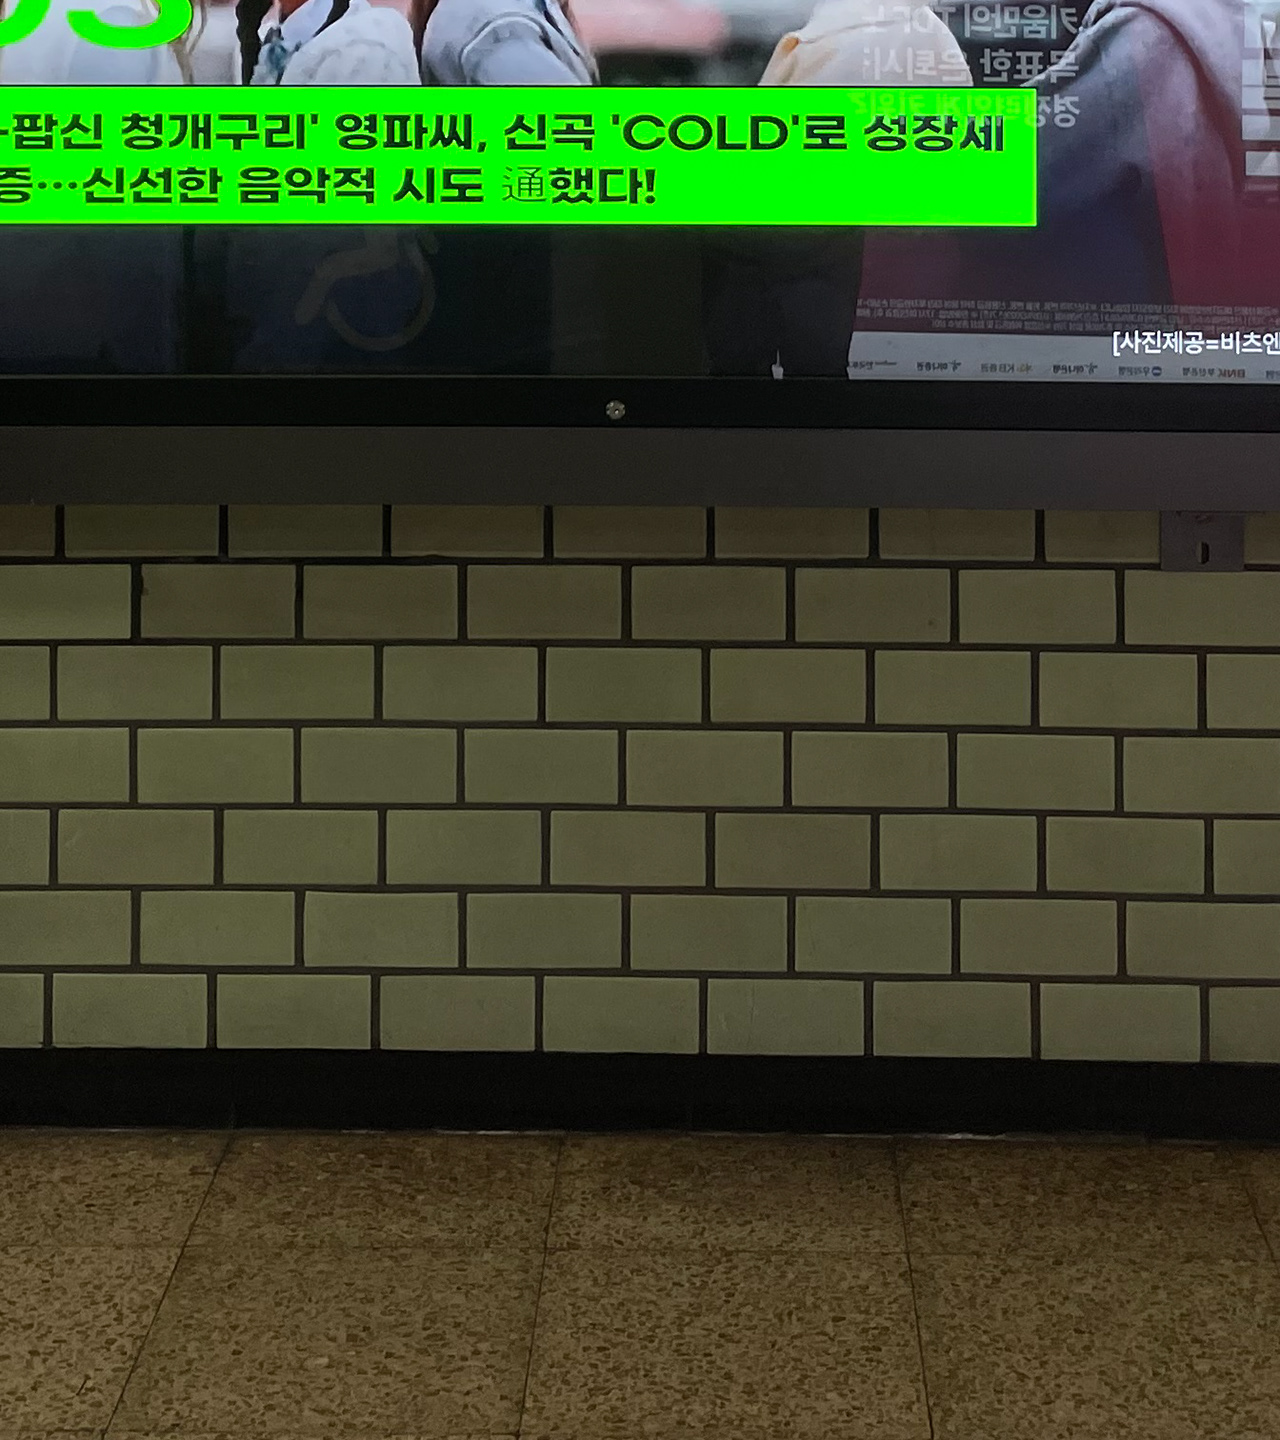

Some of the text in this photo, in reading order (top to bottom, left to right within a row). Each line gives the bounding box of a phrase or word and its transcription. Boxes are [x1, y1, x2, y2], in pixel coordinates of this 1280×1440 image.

[121, 113, 319, 151] 청개구리'
[335, 113, 487, 153] 영파씨,
[504, 113, 595, 151] 신곡
[611, 113, 848, 151] 'COLD'로
[864, 113, 1005, 152] 성장세
[237, 167, 376, 205] 음악적
[393, 167, 485, 205] 시도
